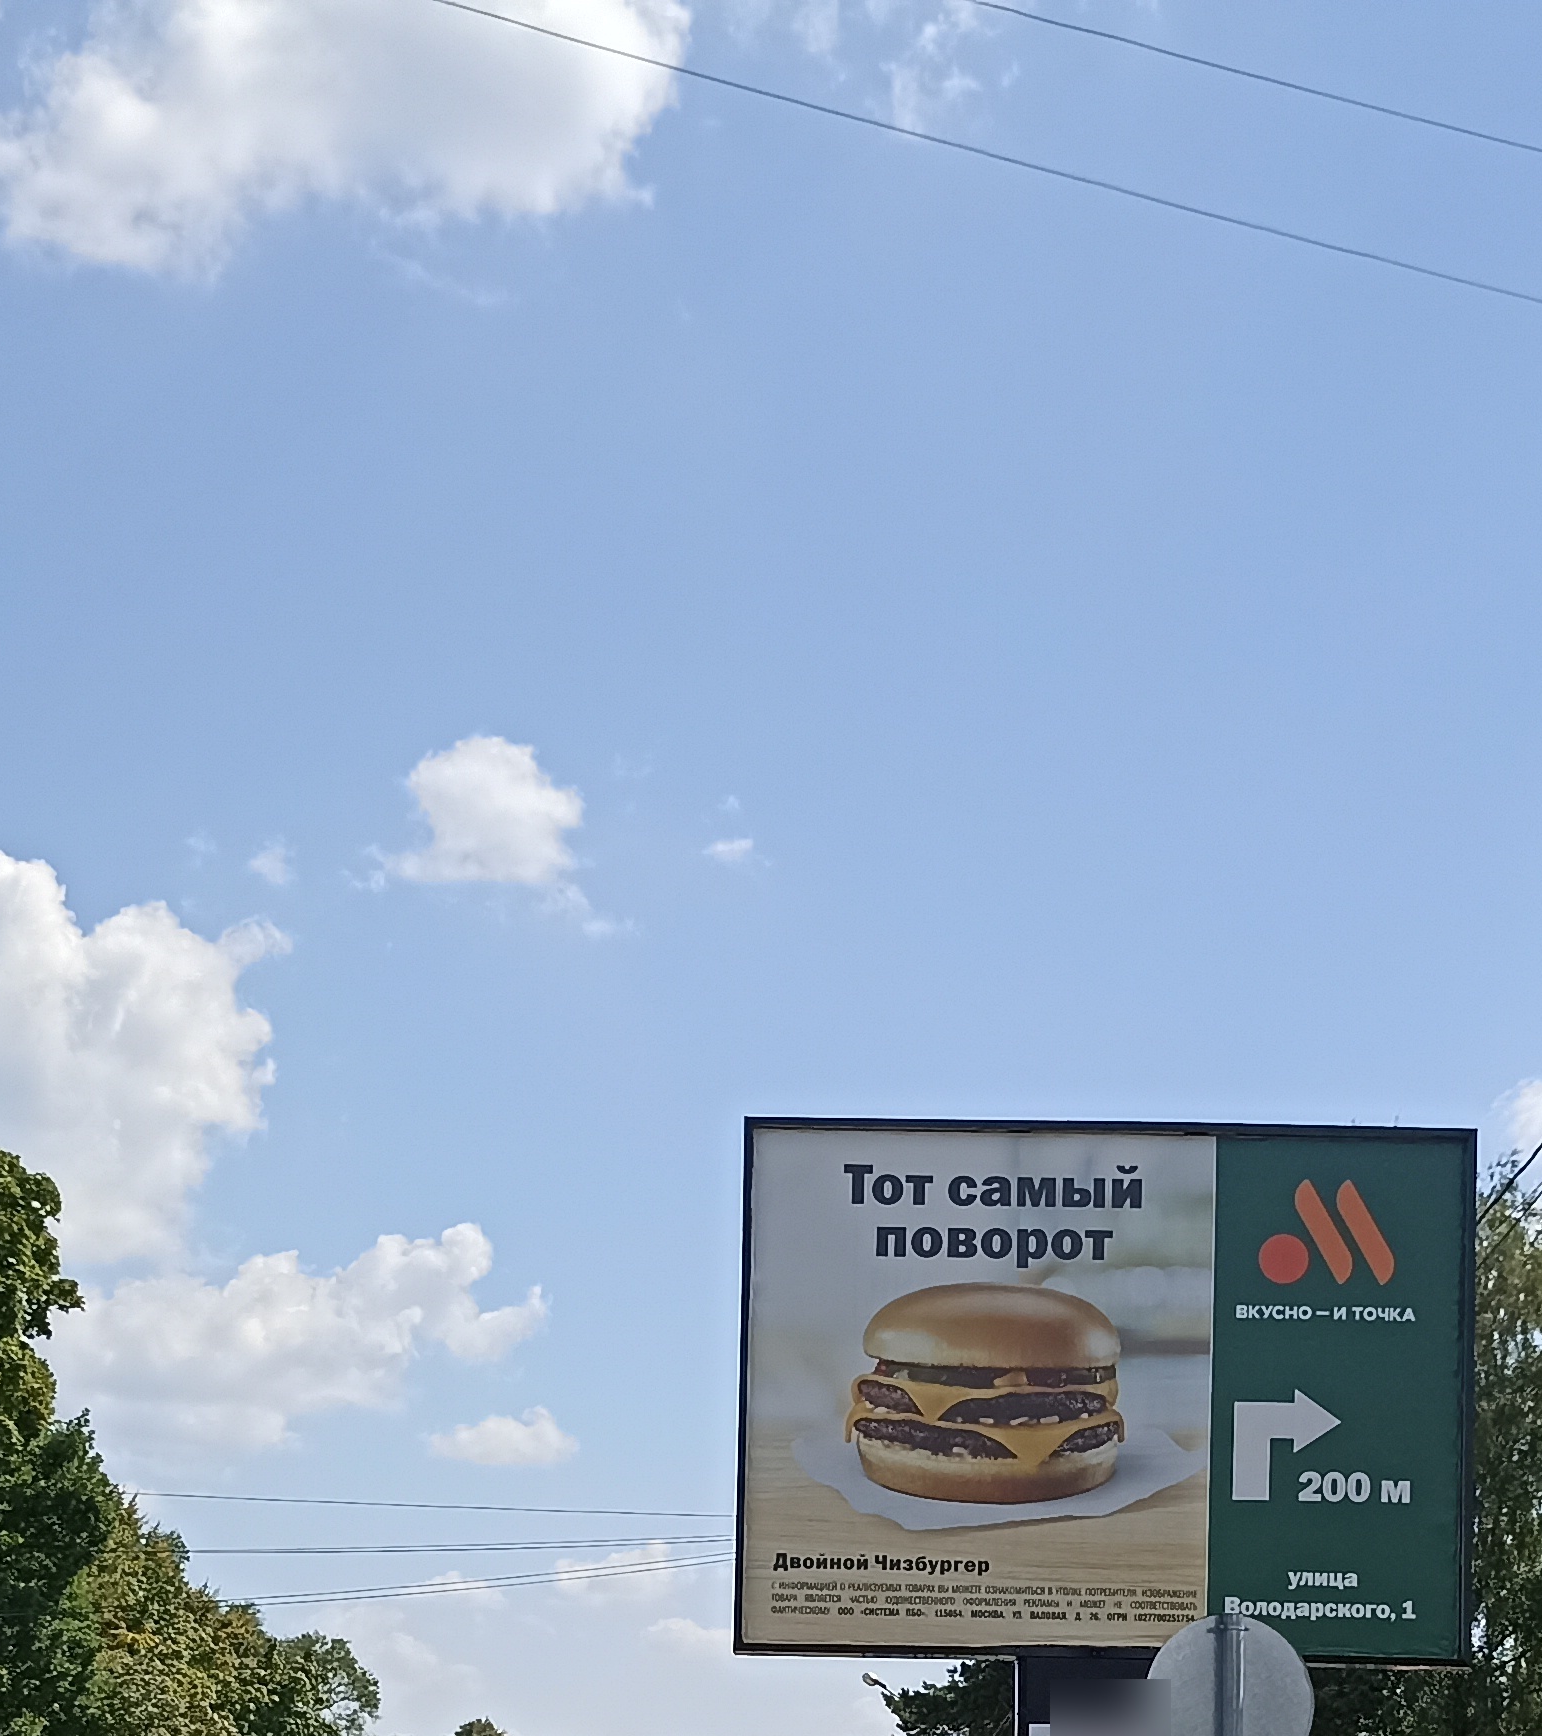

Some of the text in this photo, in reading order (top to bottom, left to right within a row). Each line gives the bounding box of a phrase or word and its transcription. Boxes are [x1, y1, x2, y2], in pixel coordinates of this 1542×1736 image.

[843, 1163, 1143, 1209] Тот самый
[875, 1226, 1114, 1269] поворот
[1235, 1304, 1313, 1320] ВКУСНО
[1333, 1306, 1347, 1321] И
[1351, 1306, 1416, 1322] ТОЧКА
[1297, 1471, 1371, 1503] 200
[772, 1553, 990, 1576] Двойной Чизбургер
[1287, 1571, 1358, 1590] улица
[837, 1606, 855, 1616] ООО
[1106, 1612, 1128, 1622] ОГРН
[1224, 1596, 1417, 1622] Володарского, 1
